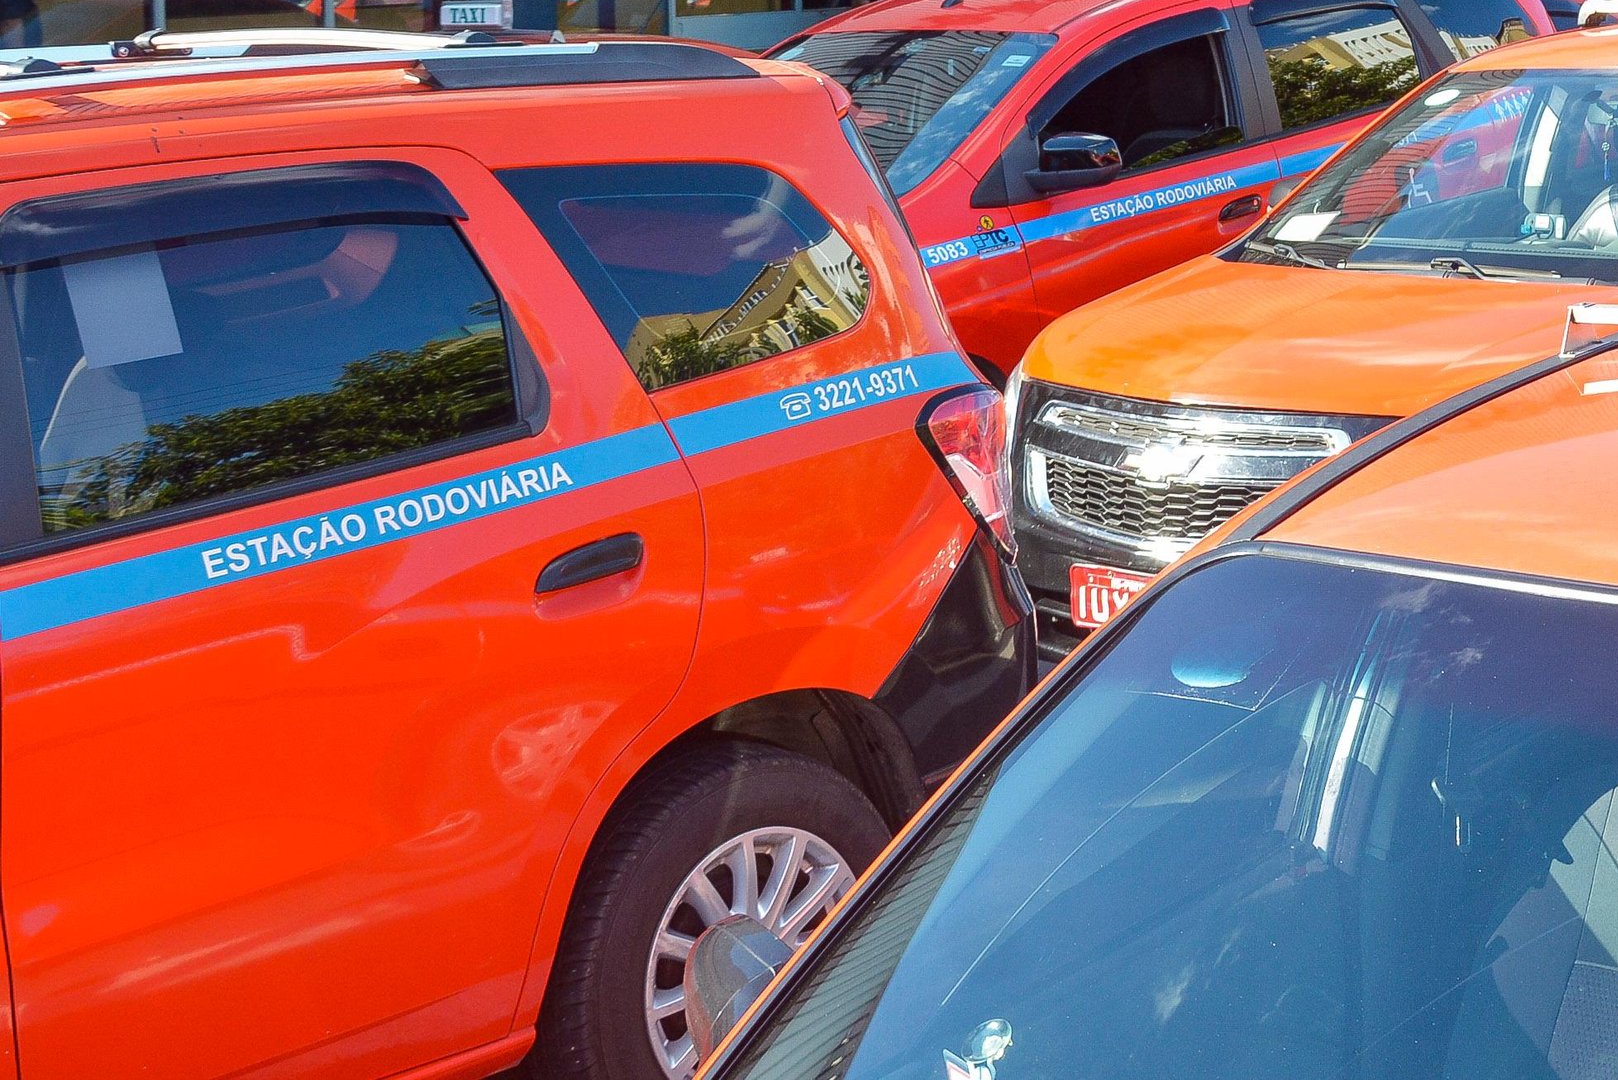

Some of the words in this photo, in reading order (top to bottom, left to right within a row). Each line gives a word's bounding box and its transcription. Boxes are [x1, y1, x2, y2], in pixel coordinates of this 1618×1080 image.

[450, 7, 486, 24] TAXI
[1090, 192, 1155, 223] ESTAÇÃO
[1156, 174, 1238, 207] RODOVIÁRIA
[926, 240, 969, 265] 5083
[814, 364, 920, 412] 3221-9371
[200, 511, 367, 581] ESTAÇÃO
[373, 462, 573, 540] RODOVIÁRIA
